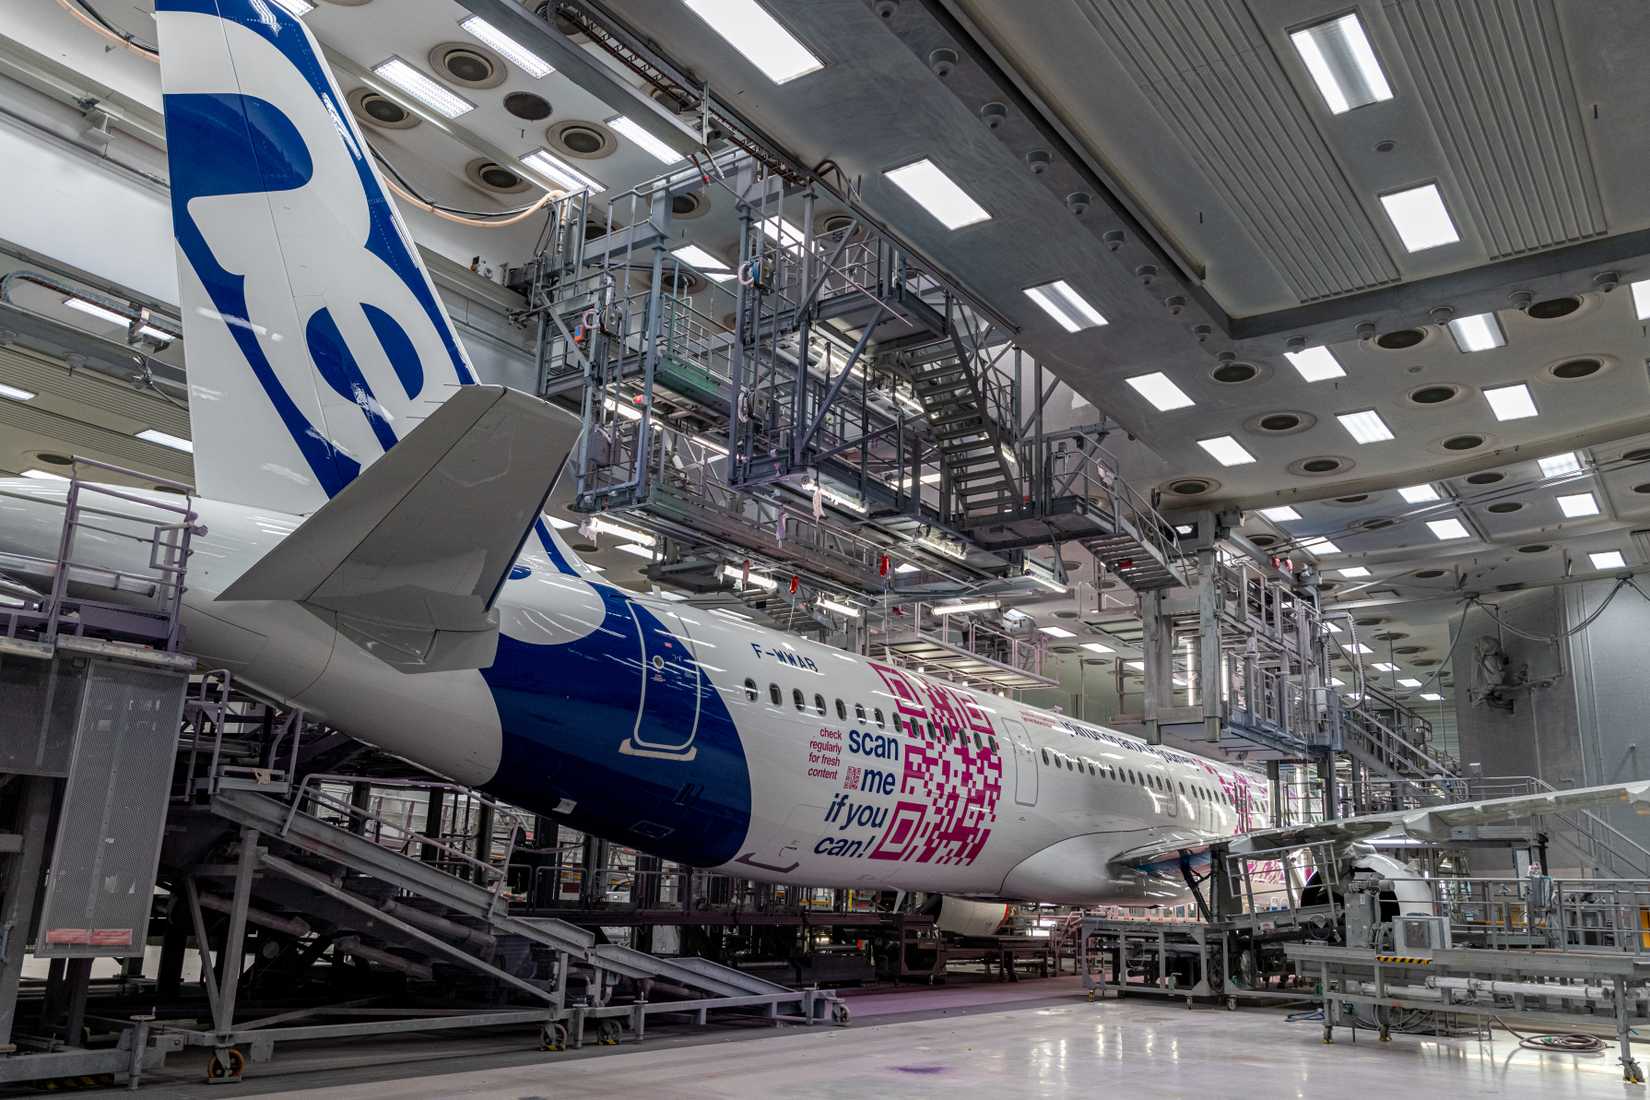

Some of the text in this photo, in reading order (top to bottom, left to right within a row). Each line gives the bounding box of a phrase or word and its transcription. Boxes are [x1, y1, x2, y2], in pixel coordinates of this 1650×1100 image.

[820, 728, 842, 740] check
[809, 740, 842, 755] regularly
[848, 729, 898, 760] scan
[808, 751, 841, 767] for fresh
[807, 768, 838, 779] content
[861, 768, 896, 795] me
[824, 793, 889, 831] if you
[813, 835, 876, 858] can!
